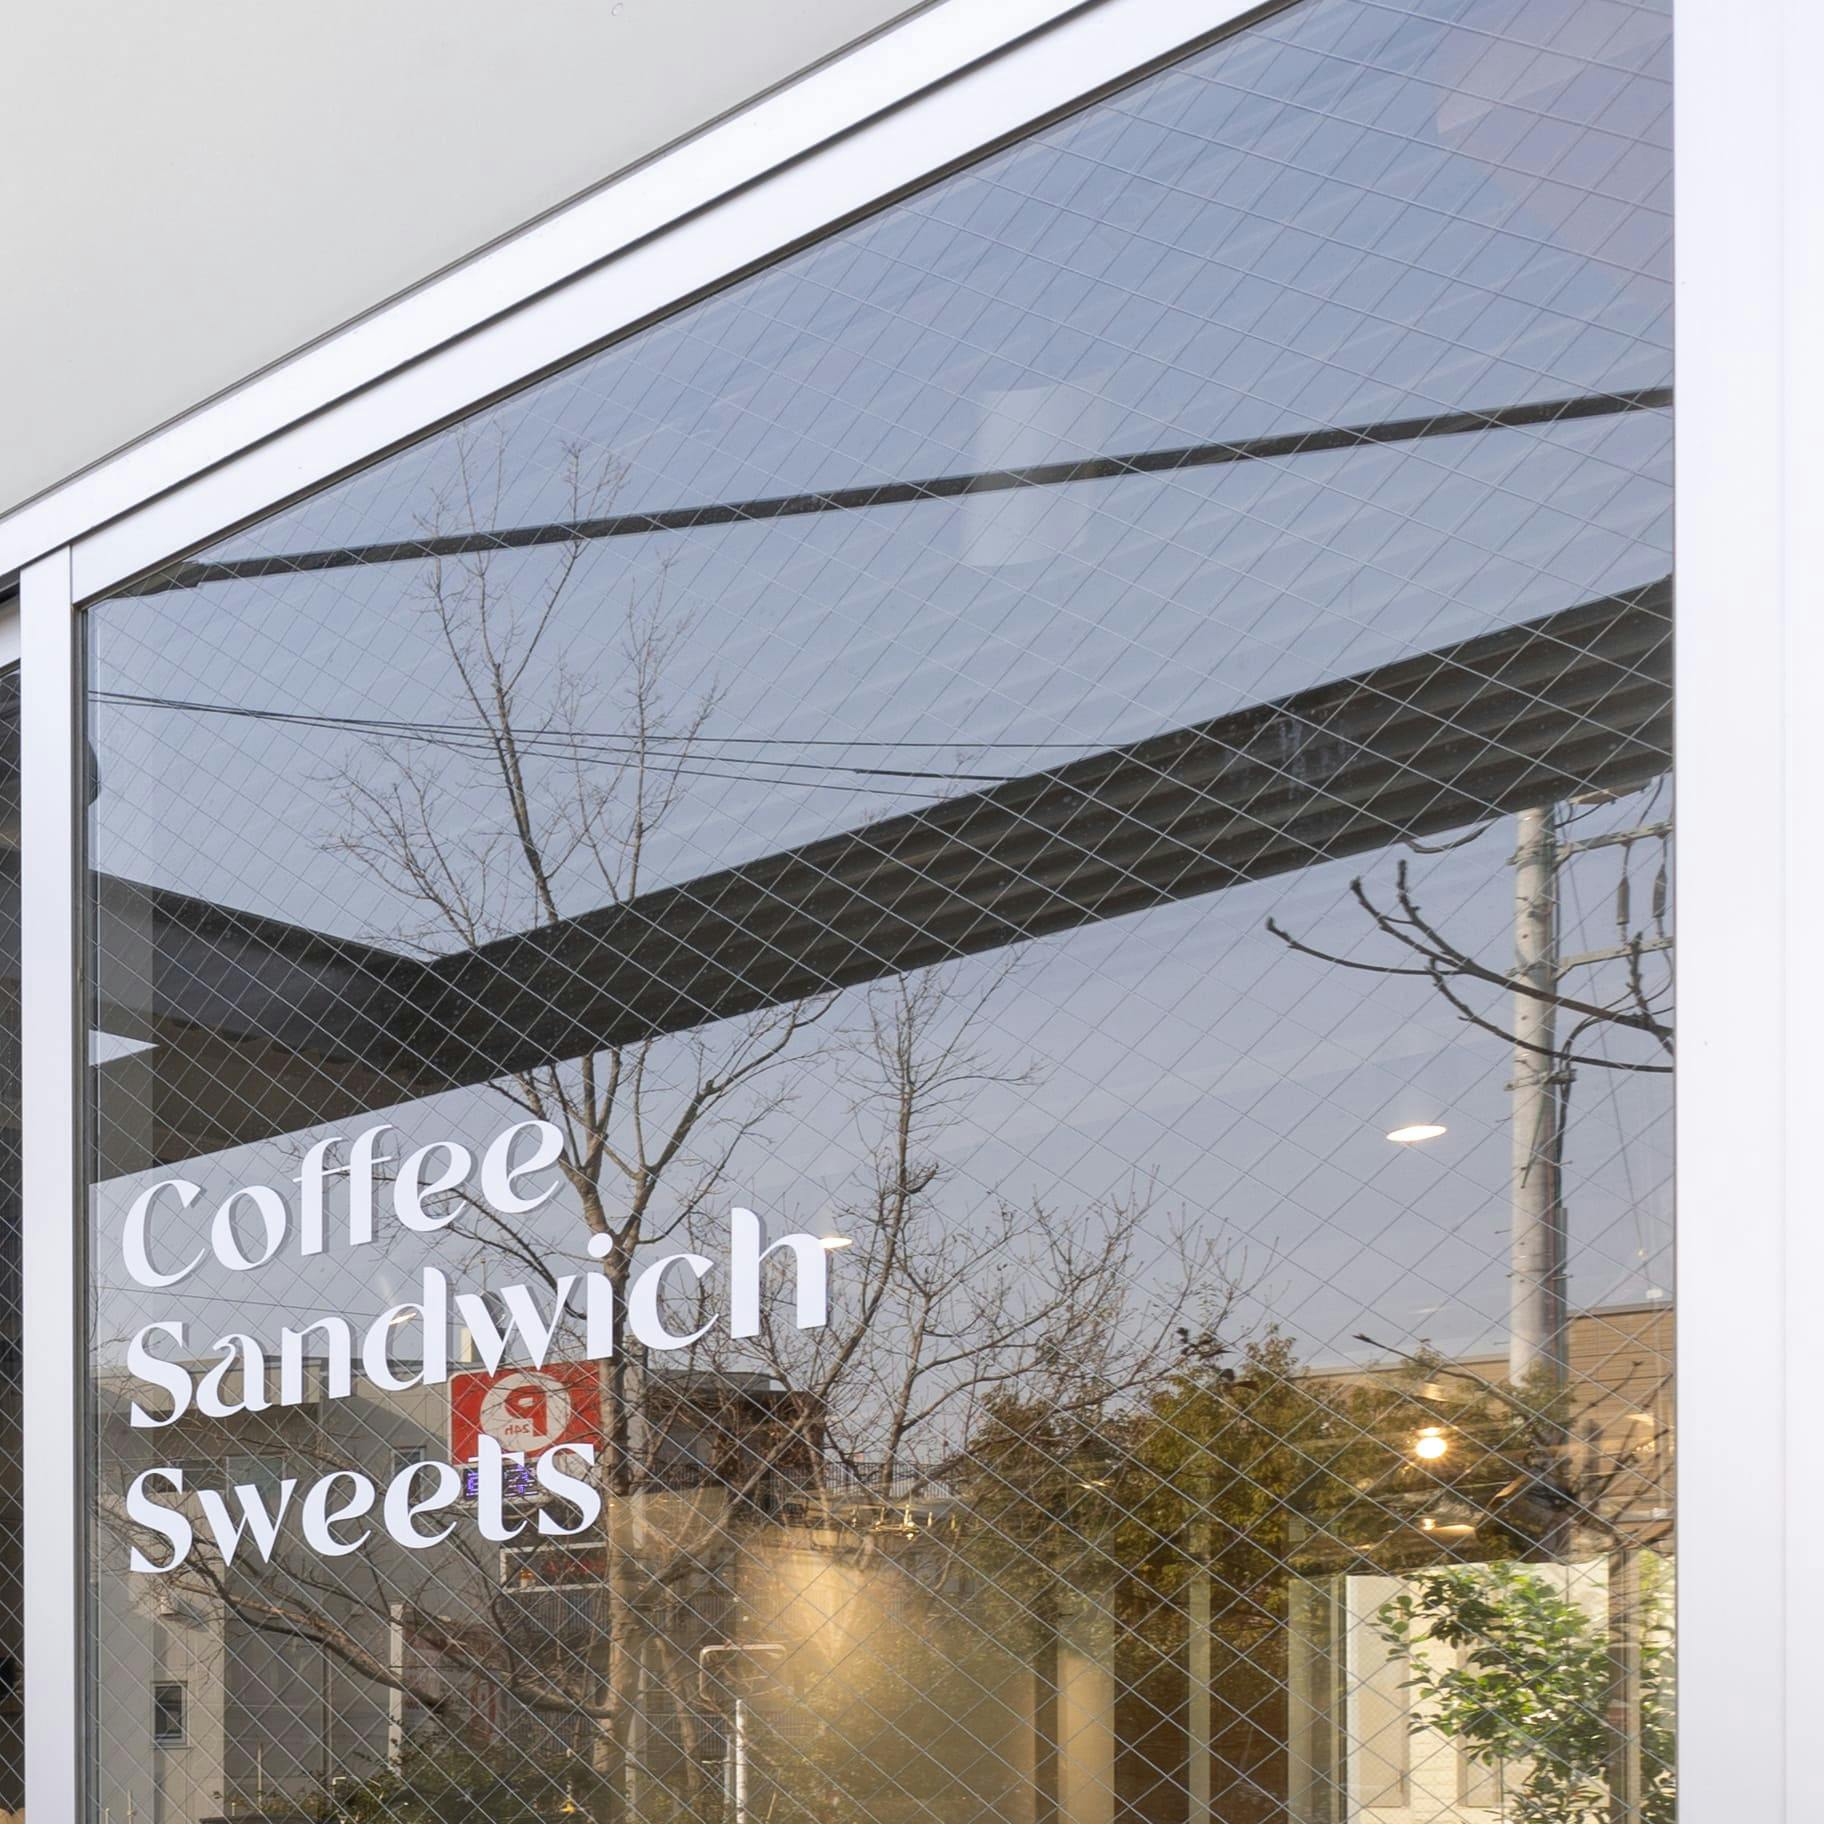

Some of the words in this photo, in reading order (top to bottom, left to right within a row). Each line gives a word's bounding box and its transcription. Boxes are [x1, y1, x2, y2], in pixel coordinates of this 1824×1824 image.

[122, 1119, 564, 1288] Coffee
[126, 1206, 828, 1428] Sandwich
[126, 1434, 602, 1574] Sweets
